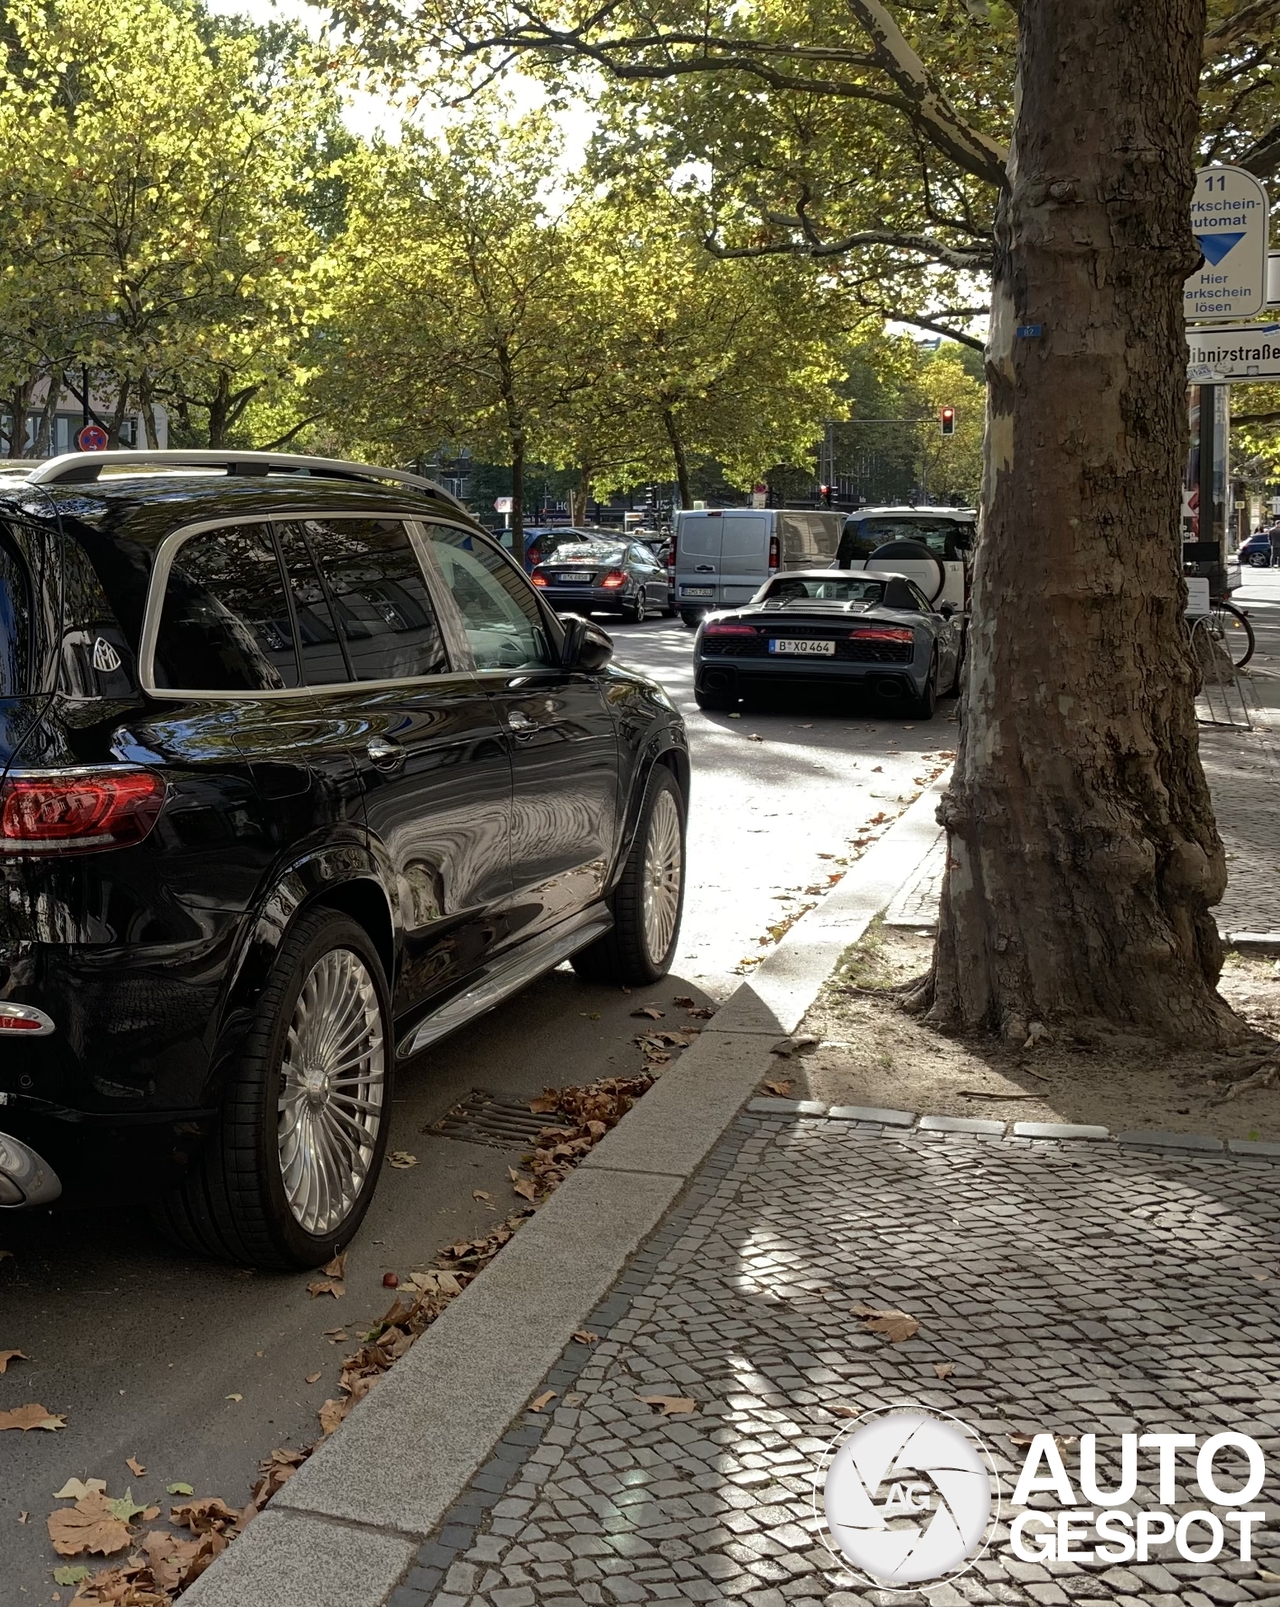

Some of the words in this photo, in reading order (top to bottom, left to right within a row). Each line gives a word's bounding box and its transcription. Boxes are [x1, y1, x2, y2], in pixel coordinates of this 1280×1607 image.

[1204, 175, 1226, 192] 11
[1191, 198, 1261, 212] rkschein-
[1200, 273, 1229, 285] Hier
[1185, 287, 1252, 300] arkschein
[1195, 302, 1232, 313] lösen
[1191, 343, 1280, 363] ibnizstraße
[779, 641, 786, 651] B
[794, 641, 807, 652] XQ
[809, 642, 829, 652] 464
